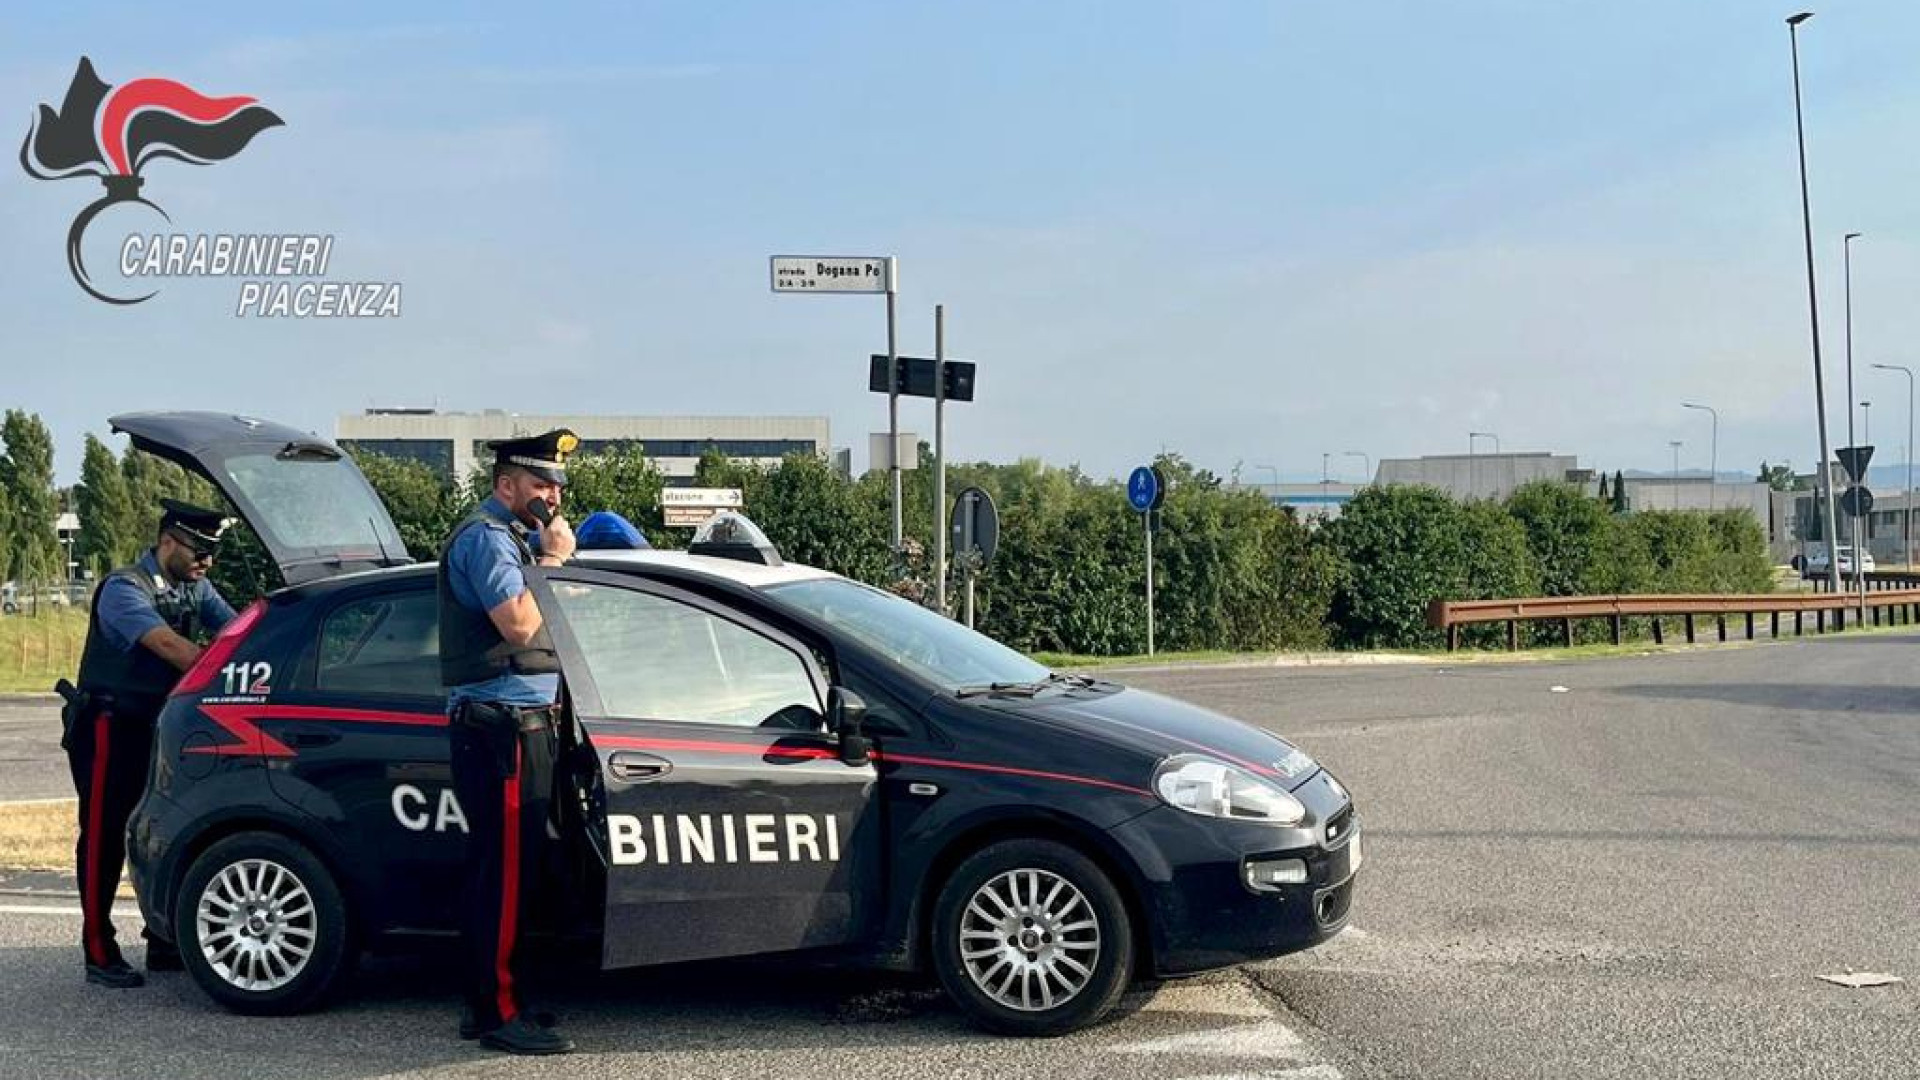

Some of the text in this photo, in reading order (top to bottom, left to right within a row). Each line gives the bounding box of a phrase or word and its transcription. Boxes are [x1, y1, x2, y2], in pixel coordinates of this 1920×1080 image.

[817, 262, 860, 278] Dogana
[865, 263, 880, 277] Po
[221, 661, 272, 694] 112
